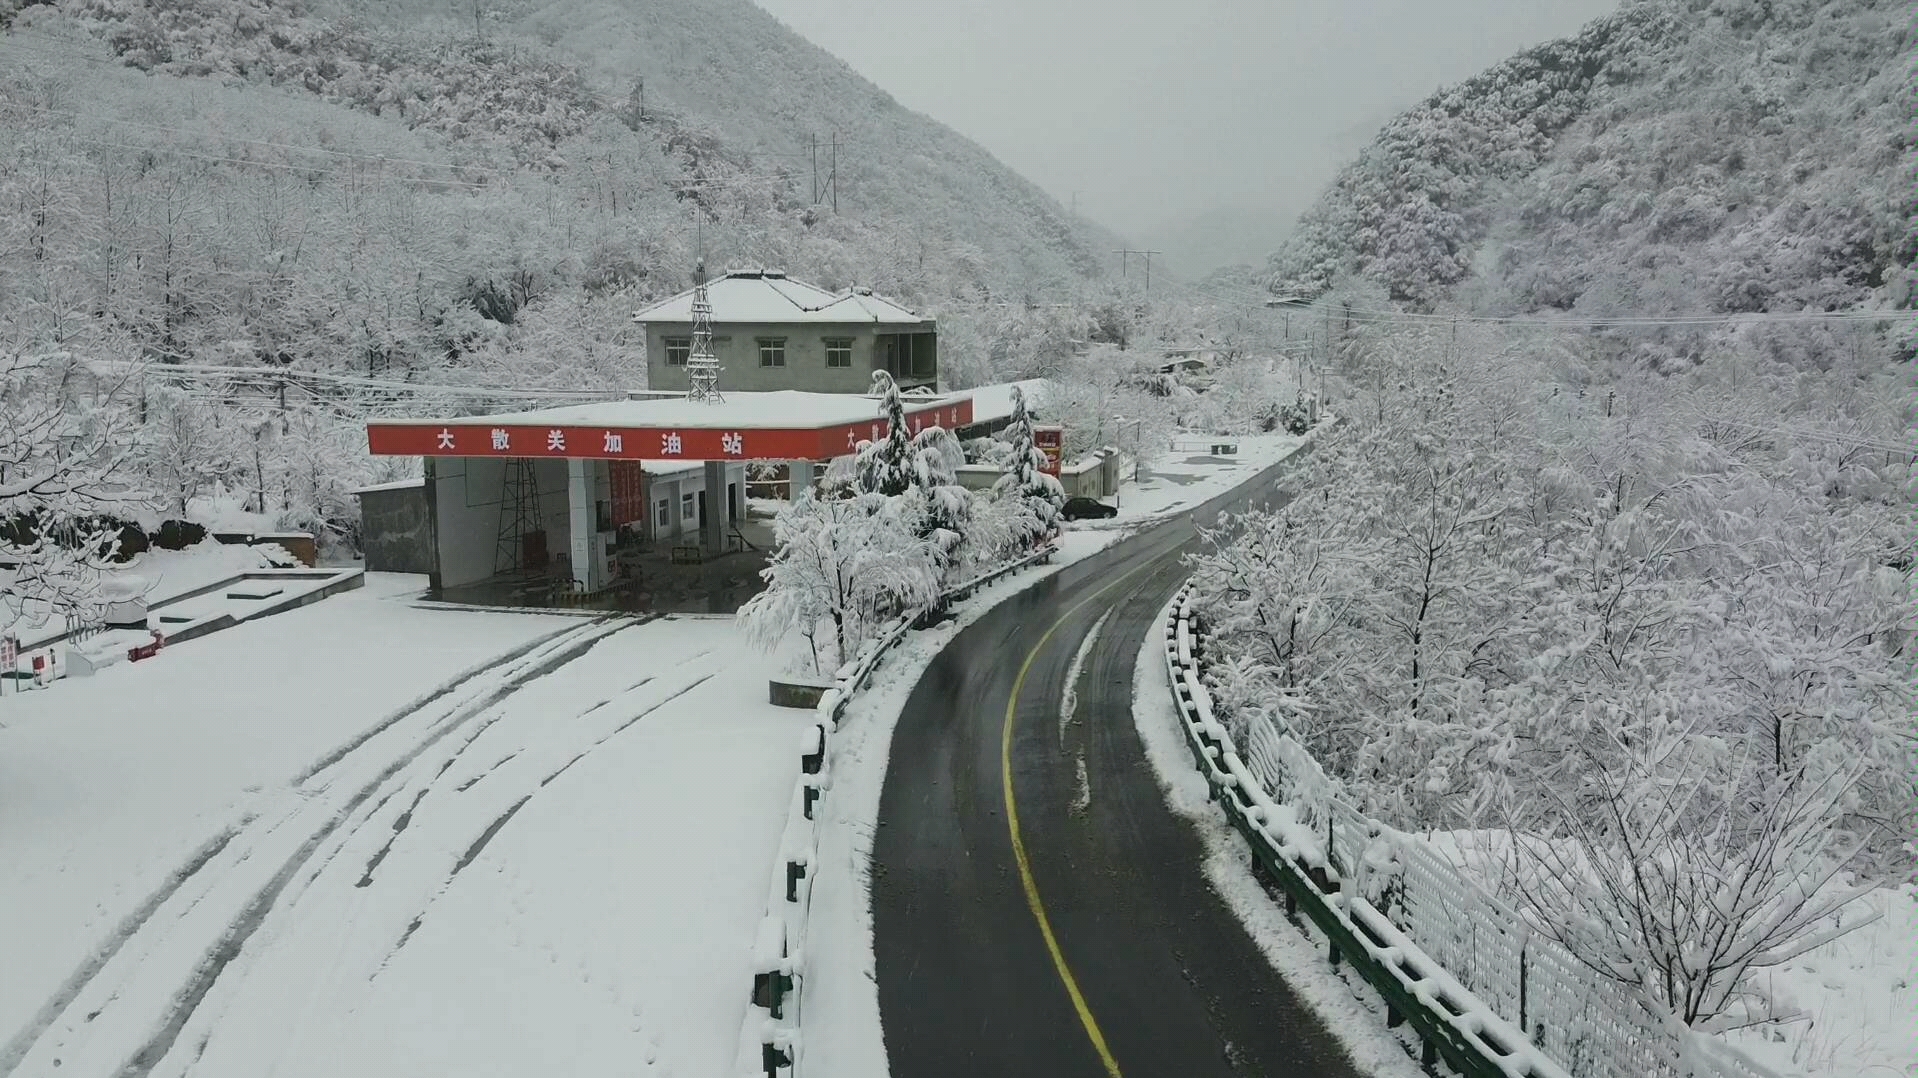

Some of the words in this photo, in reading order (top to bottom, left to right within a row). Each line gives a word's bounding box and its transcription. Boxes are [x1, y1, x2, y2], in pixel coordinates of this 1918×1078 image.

[437, 428, 743, 455] 大散关加油站
